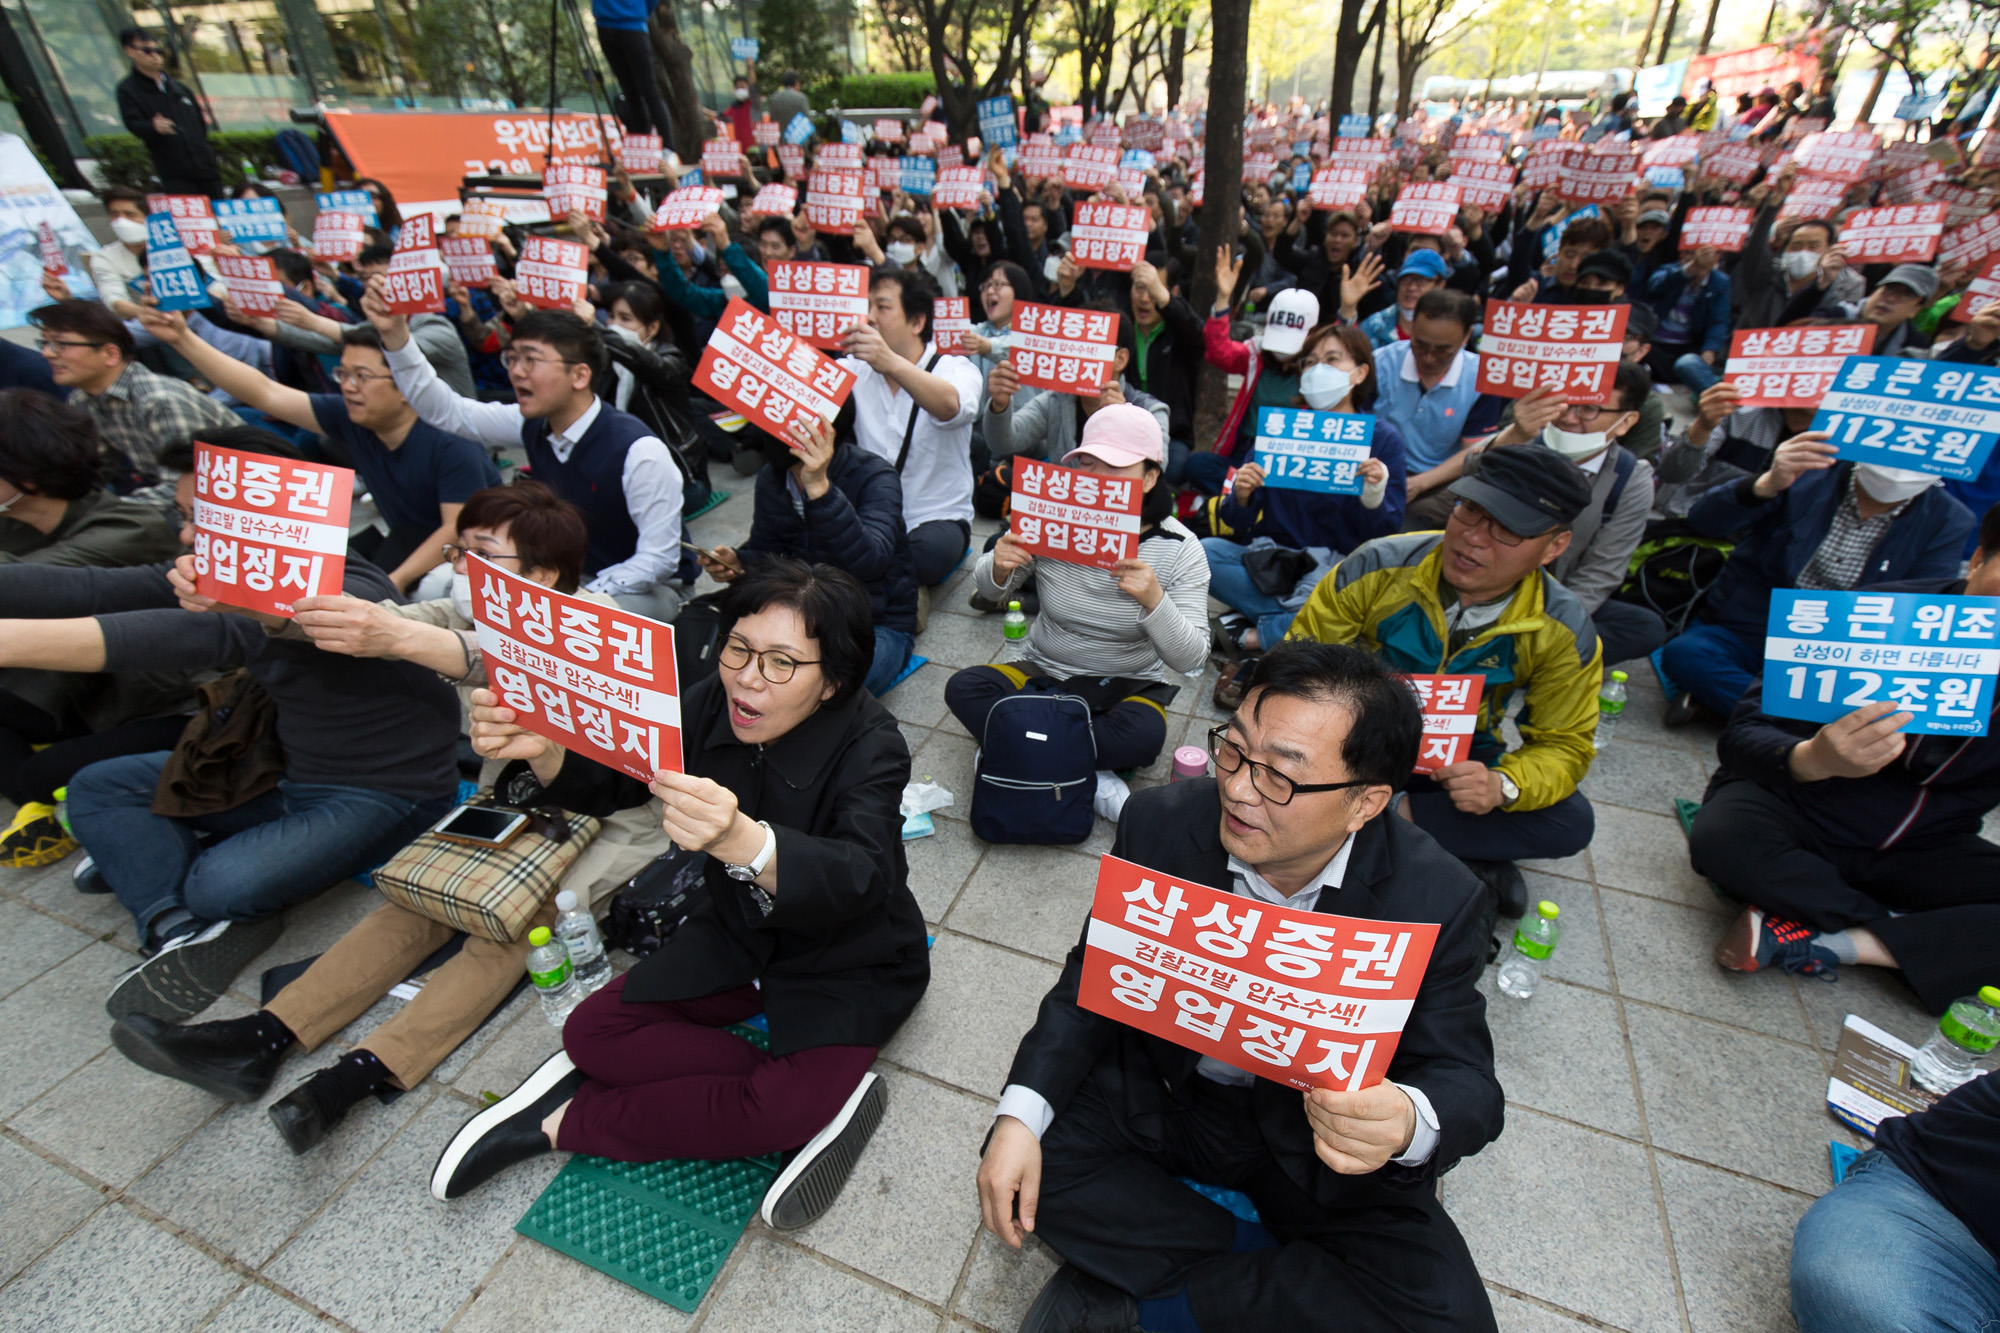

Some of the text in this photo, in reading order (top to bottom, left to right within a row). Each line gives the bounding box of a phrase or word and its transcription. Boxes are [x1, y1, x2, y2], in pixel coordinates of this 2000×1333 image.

[494, 118, 604, 154] 우간다보다
[1462, 188, 1504, 208] 업정지
[807, 205, 858, 227] 영업정지
[1078, 203, 1146, 229] 삼성증권
[1851, 203, 1942, 228] 삼성증권
[181, 230, 216, 249] 정지
[394, 215, 431, 251] 증권
[1847, 235, 1931, 258] 영업정지
[521, 238, 582, 267] 성증권
[1074, 239, 1139, 264] 영업정지
[150, 268, 201, 298] 12조원
[516, 273, 579, 304] 영업정지
[774, 264, 860, 295] 삼성증권
[814, 297, 851, 309] 압수수색!
[933, 298, 964, 318] 증권
[776, 309, 859, 339] 영업정지
[1019, 306, 1111, 341] 삼성증권
[1491, 305, 1617, 340] 삼성증권
[731, 310, 847, 397] 삼성증권
[936, 331, 966, 349] 정지
[1542, 342, 1597, 358] 압수수색!
[1741, 327, 1866, 356] 삼성증권
[730, 344, 821, 409] 검찰고발 압수수색!
[1016, 351, 1104, 386] 영업정지
[1485, 357, 1605, 393] 영업정지
[1795, 359, 1842, 370] 압수수색
[1844, 361, 2000, 404] 통 큰 위조
[1265, 411, 1366, 441] 통 큰 위조
[1838, 396, 1986, 426] 삼성이 하면 다릅니다
[1318, 445, 1357, 458] 다릅니다
[1823, 413, 1981, 465] 112조원
[197, 450, 334, 517] 삼성증권
[1262, 453, 1359, 485] 112조원
[1021, 464, 1131, 511] 삼성증권
[1028, 500, 1119, 527] 검찰고발 압수수색!
[240, 516, 309, 545] 압수수색!
[1018, 516, 1128, 561] 영업정지
[194, 532, 324, 599] 영업정지
[480, 573, 654, 682] 삼성증권
[1786, 596, 1996, 641] 통 큰 위조
[1792, 643, 1981, 669] 삼성이 하면 다릅니다
[499, 638, 641, 711] 검찰고발 압수수색!
[1786, 666, 1982, 718] 112조원
[494, 666, 660, 773] 영업정지
[1121, 878, 1412, 991] 삼성증권
[1134, 940, 1367, 1028] 검찰고발 압수수색!
[1109, 964, 1377, 1092] 영업정지
